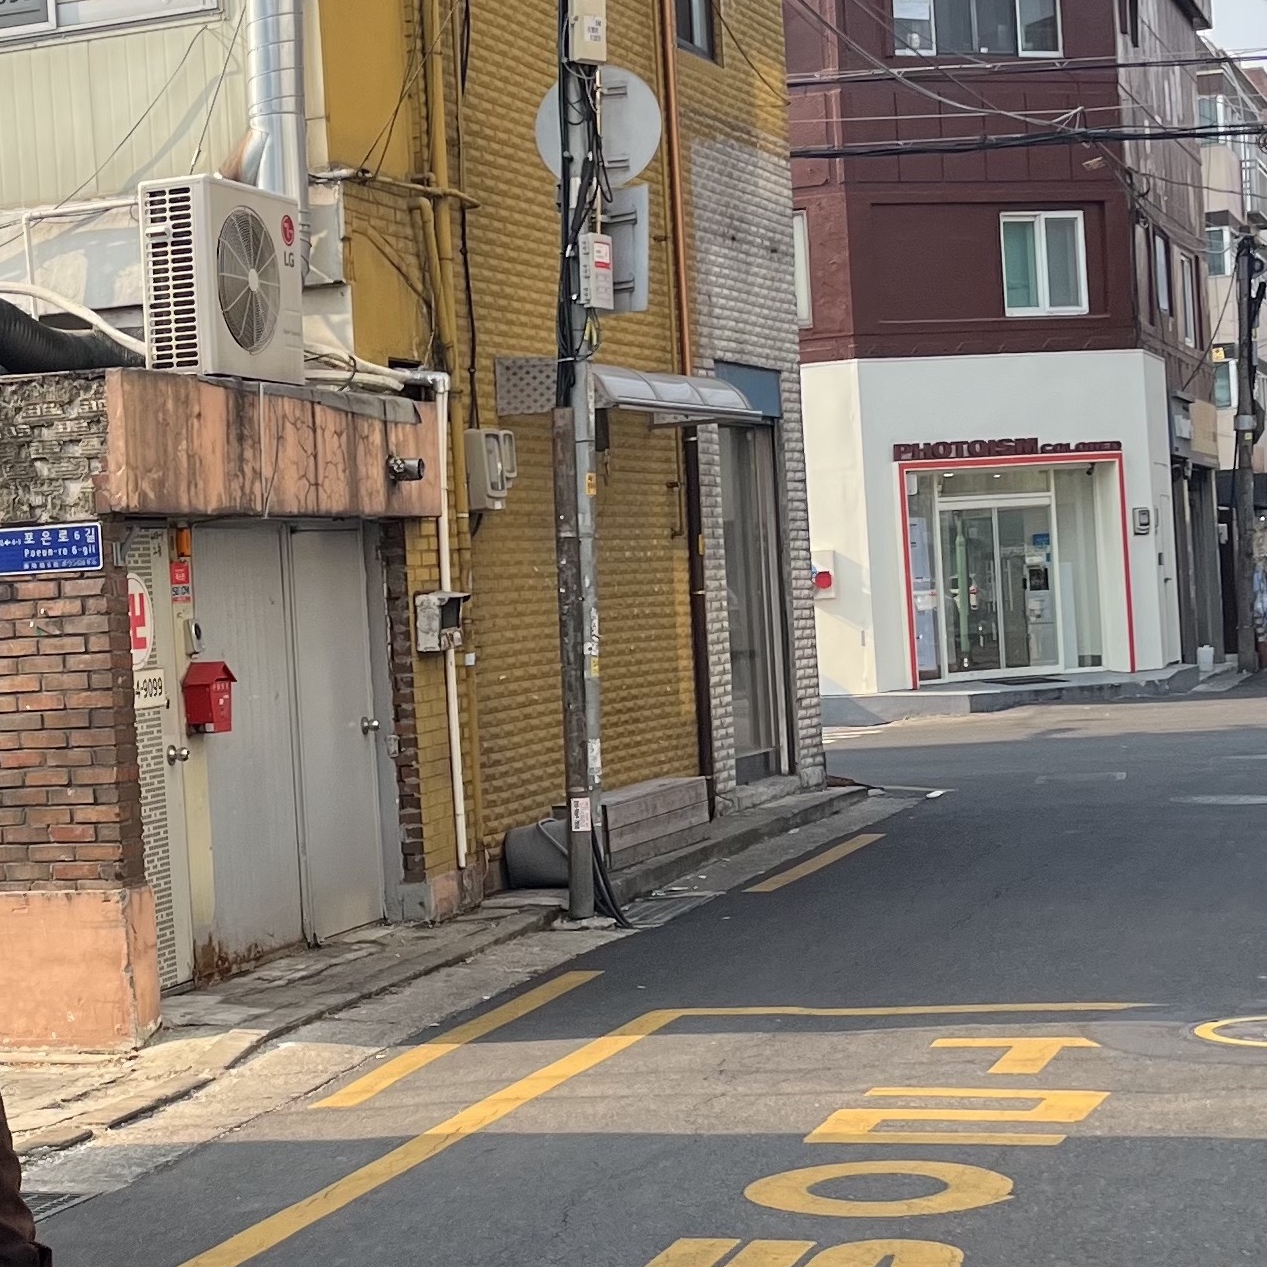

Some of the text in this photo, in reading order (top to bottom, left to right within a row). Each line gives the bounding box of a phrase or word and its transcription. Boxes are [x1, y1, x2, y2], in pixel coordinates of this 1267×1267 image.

[283, 250, 295, 268] LG
[893, 437, 1038, 462] PHOTOISM
[24, 545, 96, 558] Poeun-ro 6-gil
